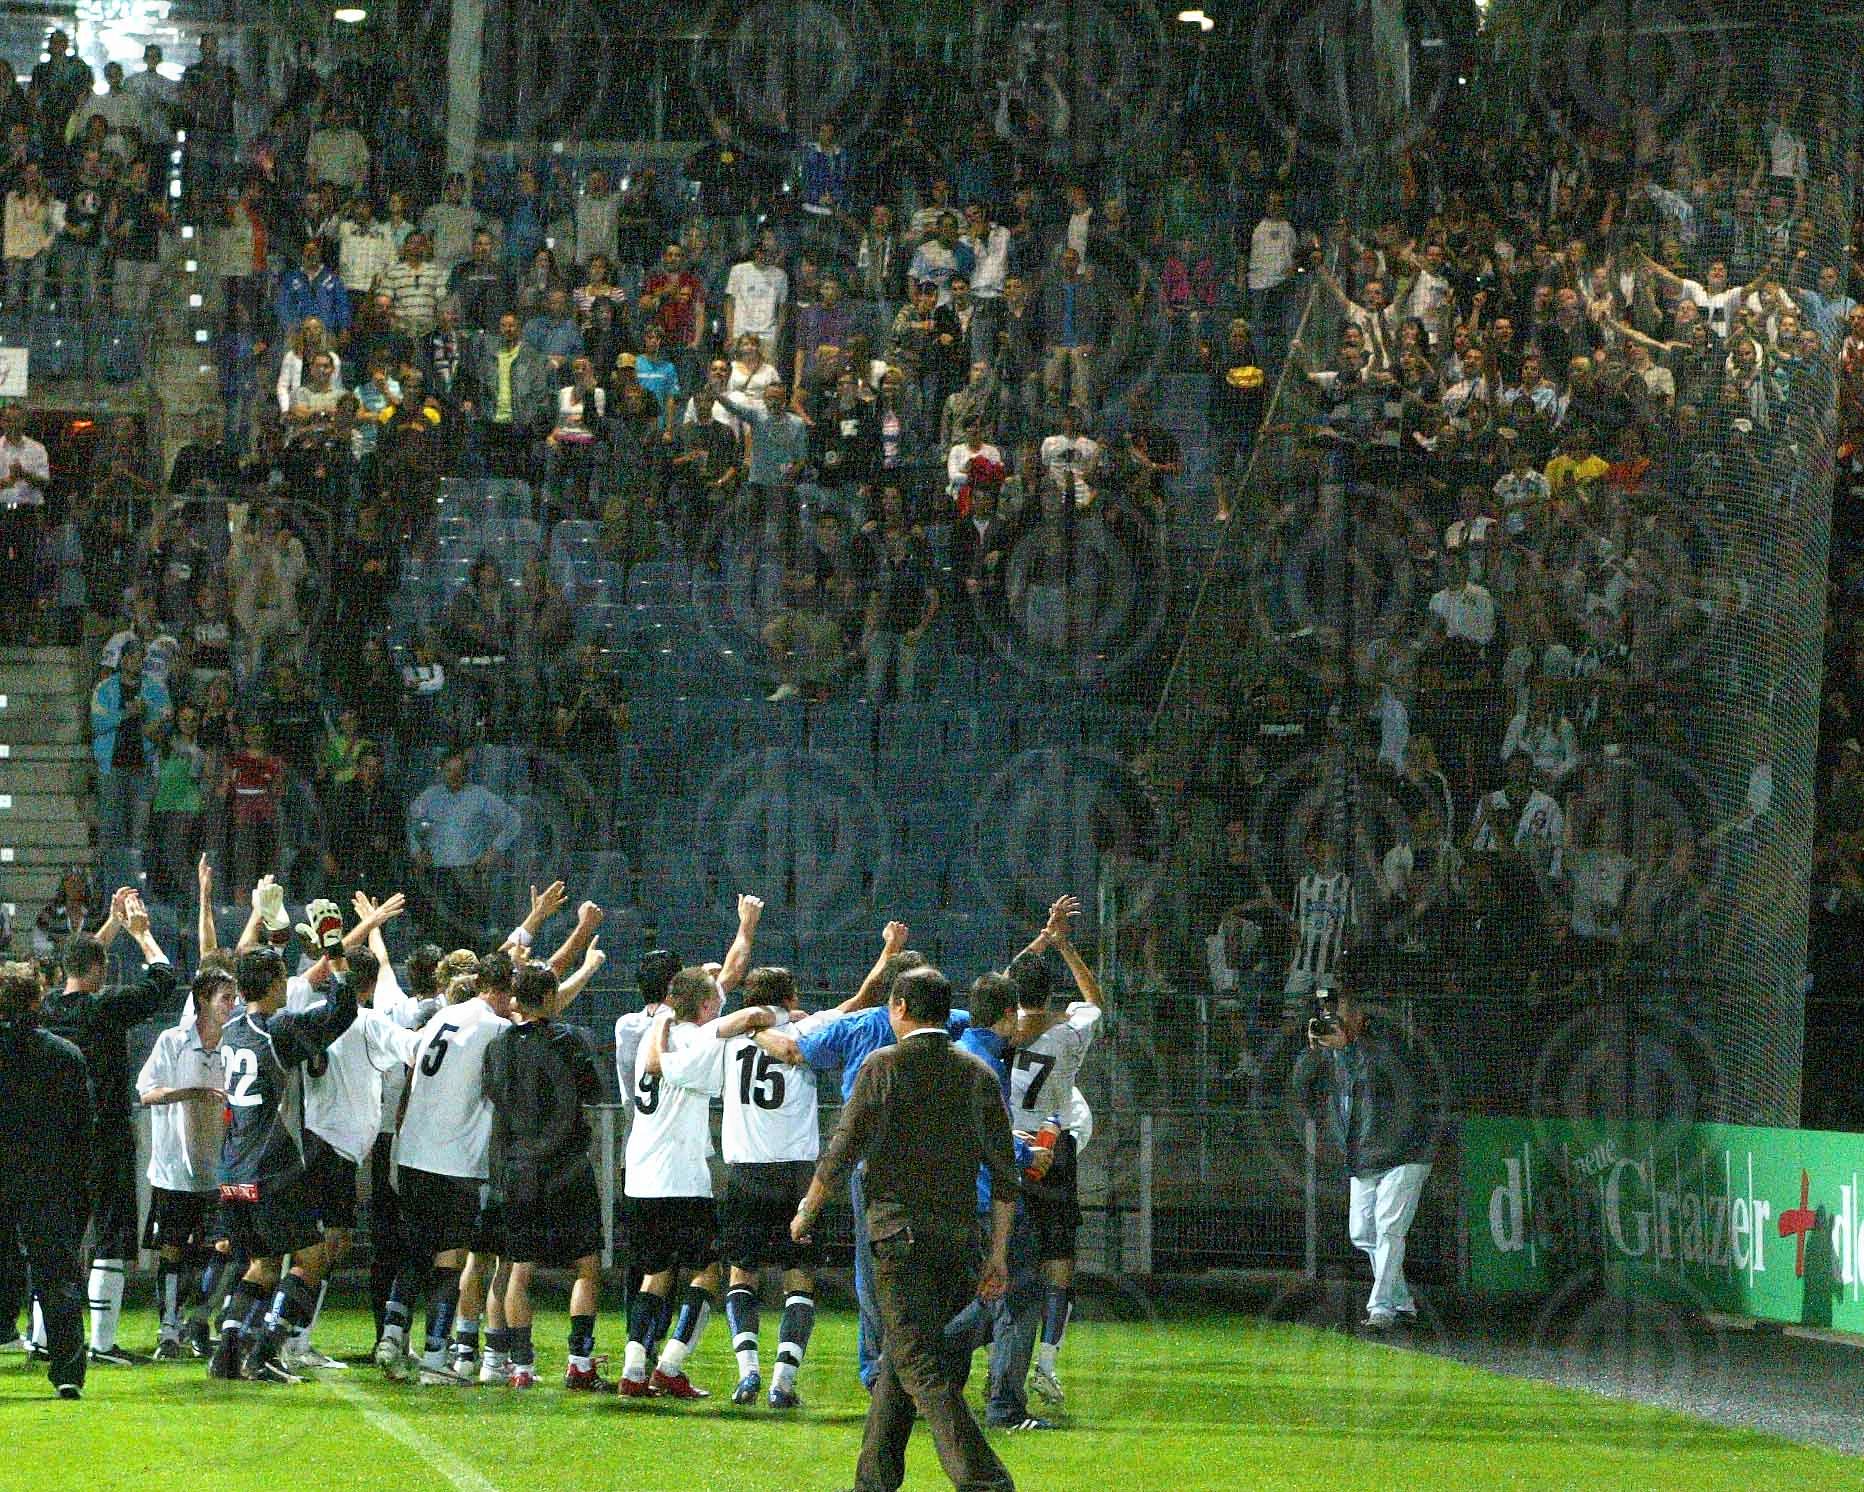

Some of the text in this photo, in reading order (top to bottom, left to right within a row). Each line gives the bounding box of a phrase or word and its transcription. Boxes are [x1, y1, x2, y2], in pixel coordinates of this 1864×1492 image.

[421, 1023, 460, 1077] 5
[736, 1045, 785, 1110] 15
[634, 1071, 663, 1115] 9
[1018, 1050, 1056, 1109] 7
